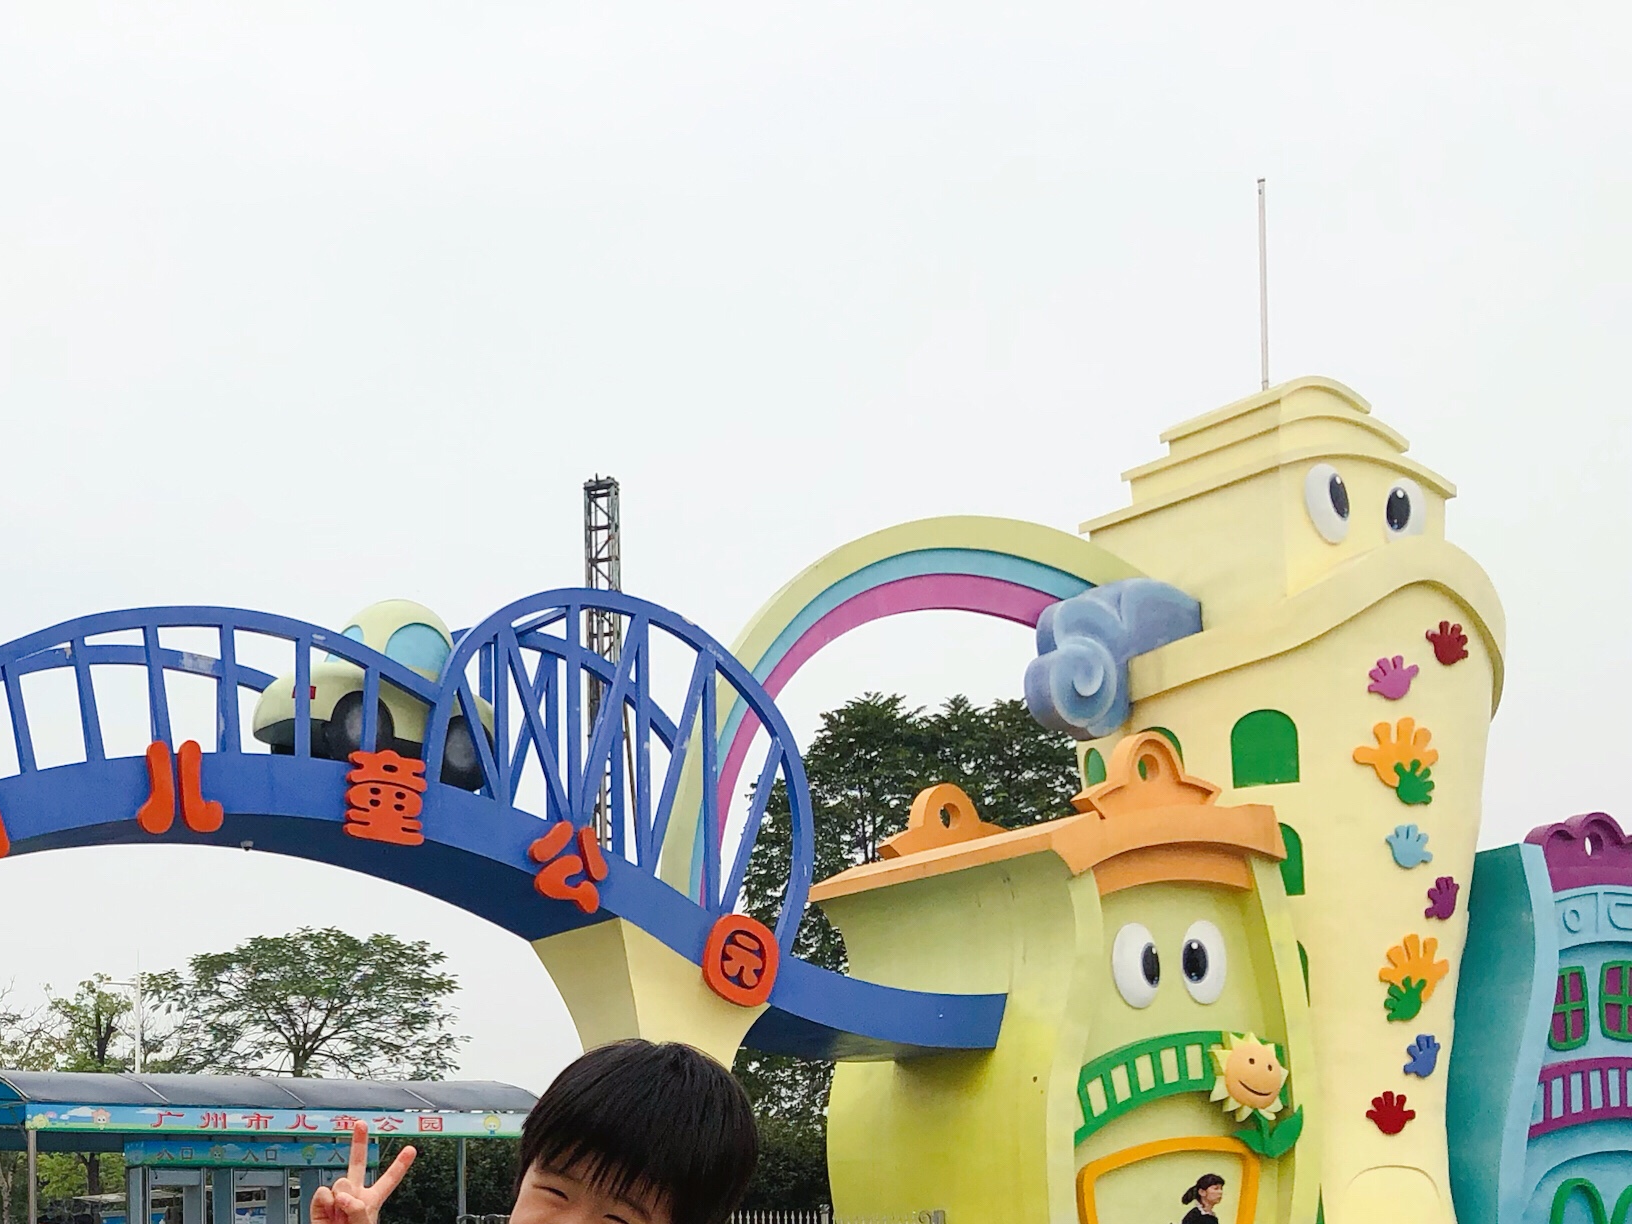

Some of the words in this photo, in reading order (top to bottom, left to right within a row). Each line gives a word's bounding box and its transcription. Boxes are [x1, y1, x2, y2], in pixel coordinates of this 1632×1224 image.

[150, 1110, 445, 1133] 广州市儿童公园
[241, 1146, 277, 1162] 入口
